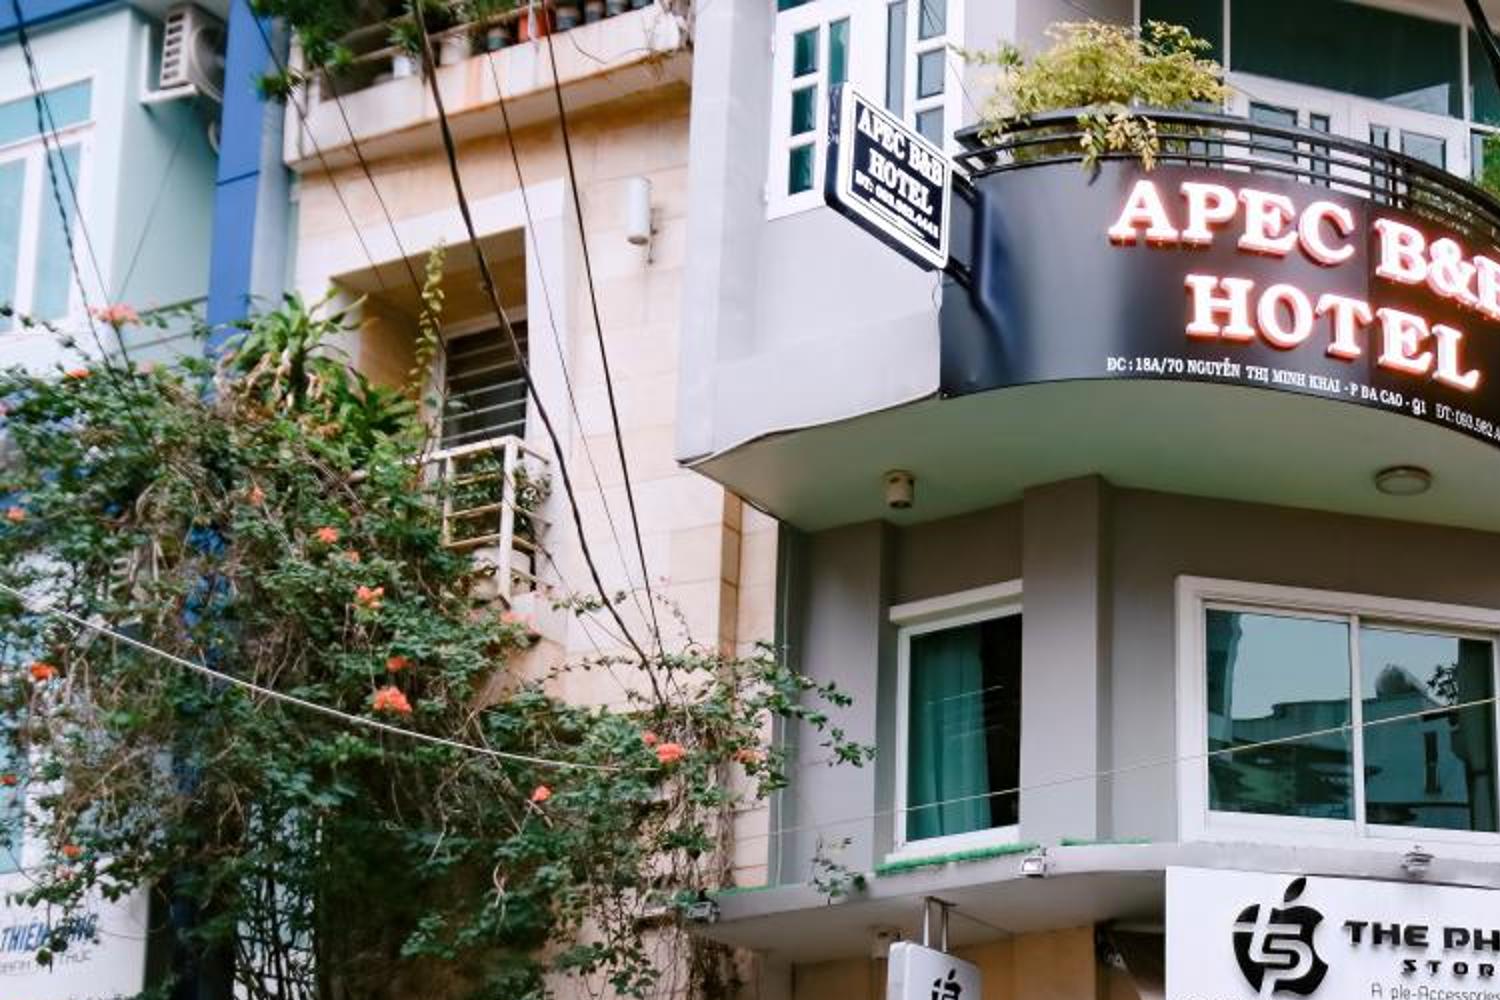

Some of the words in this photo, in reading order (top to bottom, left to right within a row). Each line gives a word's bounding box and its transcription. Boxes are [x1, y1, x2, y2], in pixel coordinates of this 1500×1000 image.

[857, 107, 905, 159] APEC
[868, 147, 934, 215] HOTEL
[1107, 178, 1356, 267] APEC
[1183, 274, 1481, 391] HOTEL
[1246, 366, 1269, 384] THỊ
[1272, 369, 1305, 388] MINH
[1309, 374, 1340, 393] KHAI
[1380, 389, 1403, 407] CAO
[1343, 920, 1429, 947] THE
